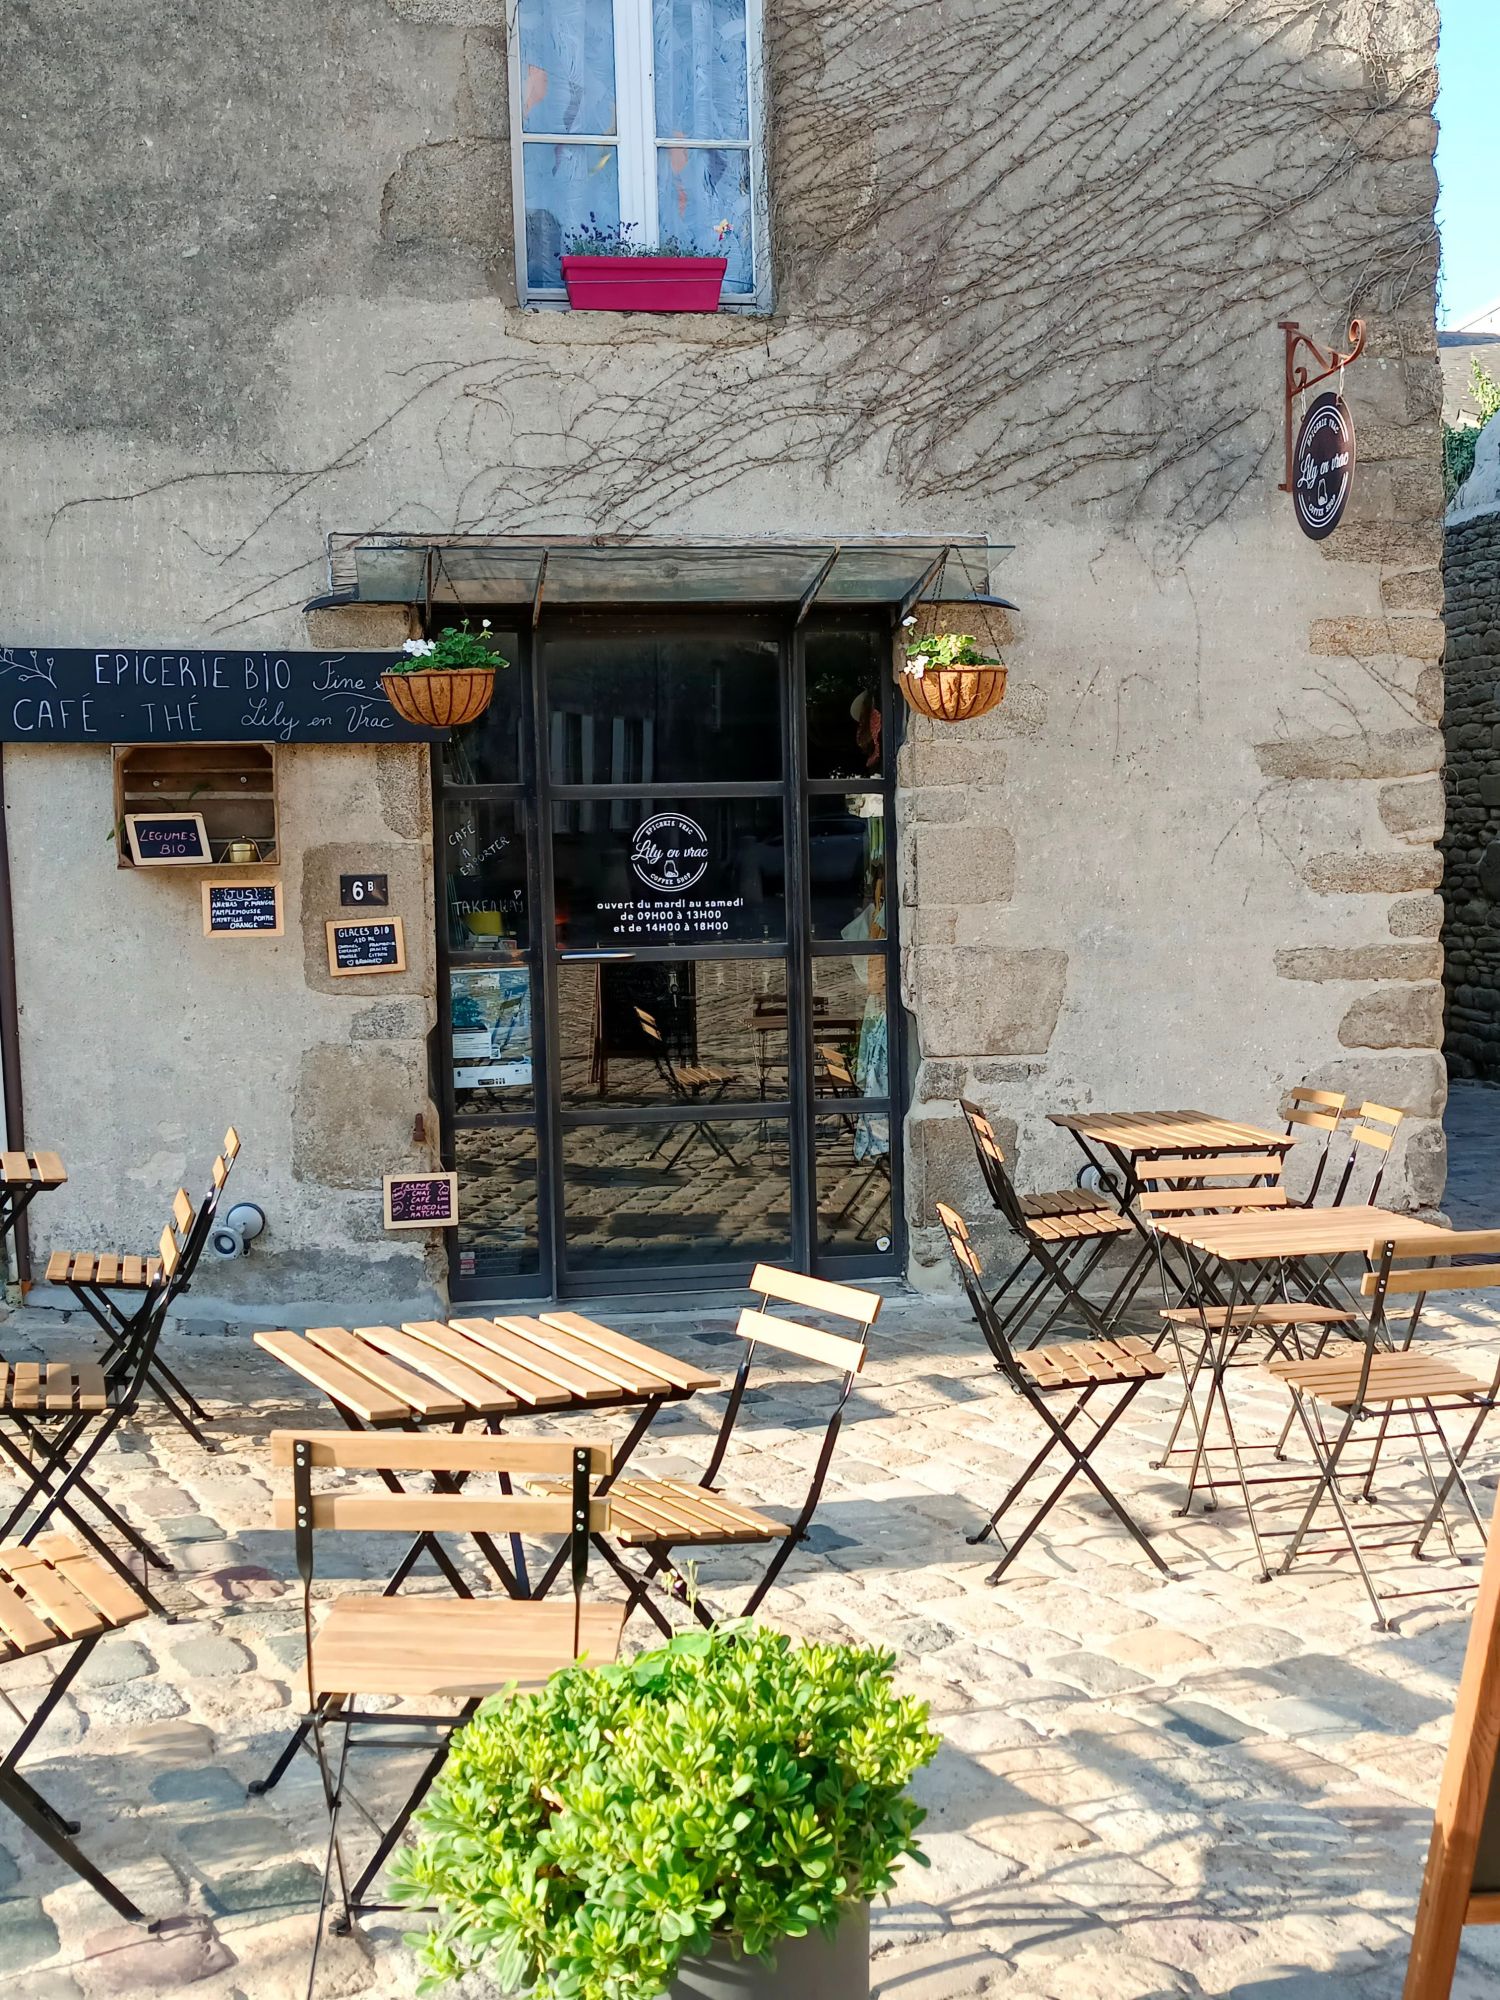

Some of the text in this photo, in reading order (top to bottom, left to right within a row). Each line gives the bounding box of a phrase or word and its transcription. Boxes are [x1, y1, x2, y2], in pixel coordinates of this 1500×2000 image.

[1297, 453, 1318, 489] Lily
[95, 651, 230, 688] EPICERIE
[245, 652, 291, 693] BIO
[312, 656, 366, 691] Fine
[13, 692, 202, 733] CAFÉ THÉ
[241, 697, 394, 741] Lily en Vrac
[448, 820, 476, 846] CAFÉ
[645, 820, 694, 836] EPICERIE VRAC
[140, 829, 197, 841] LEGUMES
[160, 844, 186, 855] BIO
[631, 839, 709, 864] Lily en vrac
[459, 836, 510, 876] EMPORTER
[650, 872, 691, 885] COFFEE SHOP
[227, 889, 253, 899] JUS
[597, 901, 634, 909] ouvert
[637, 900, 651, 909] du
[654, 899, 686, 909] mardi
[704, 898, 744, 908] samedi
[212, 908, 261, 916] PAMPLEMOUSSE
[620, 910, 722, 920] de 09H00 à 13H00
[338, 926, 390, 937] GLACES BIO
[628, 923, 642, 932] de
[645, 923, 681, 932] 14H00
[683, 923, 690, 931] à
[693, 921, 729, 931] 18H00
[410, 1210, 440, 1218] MATCHA
